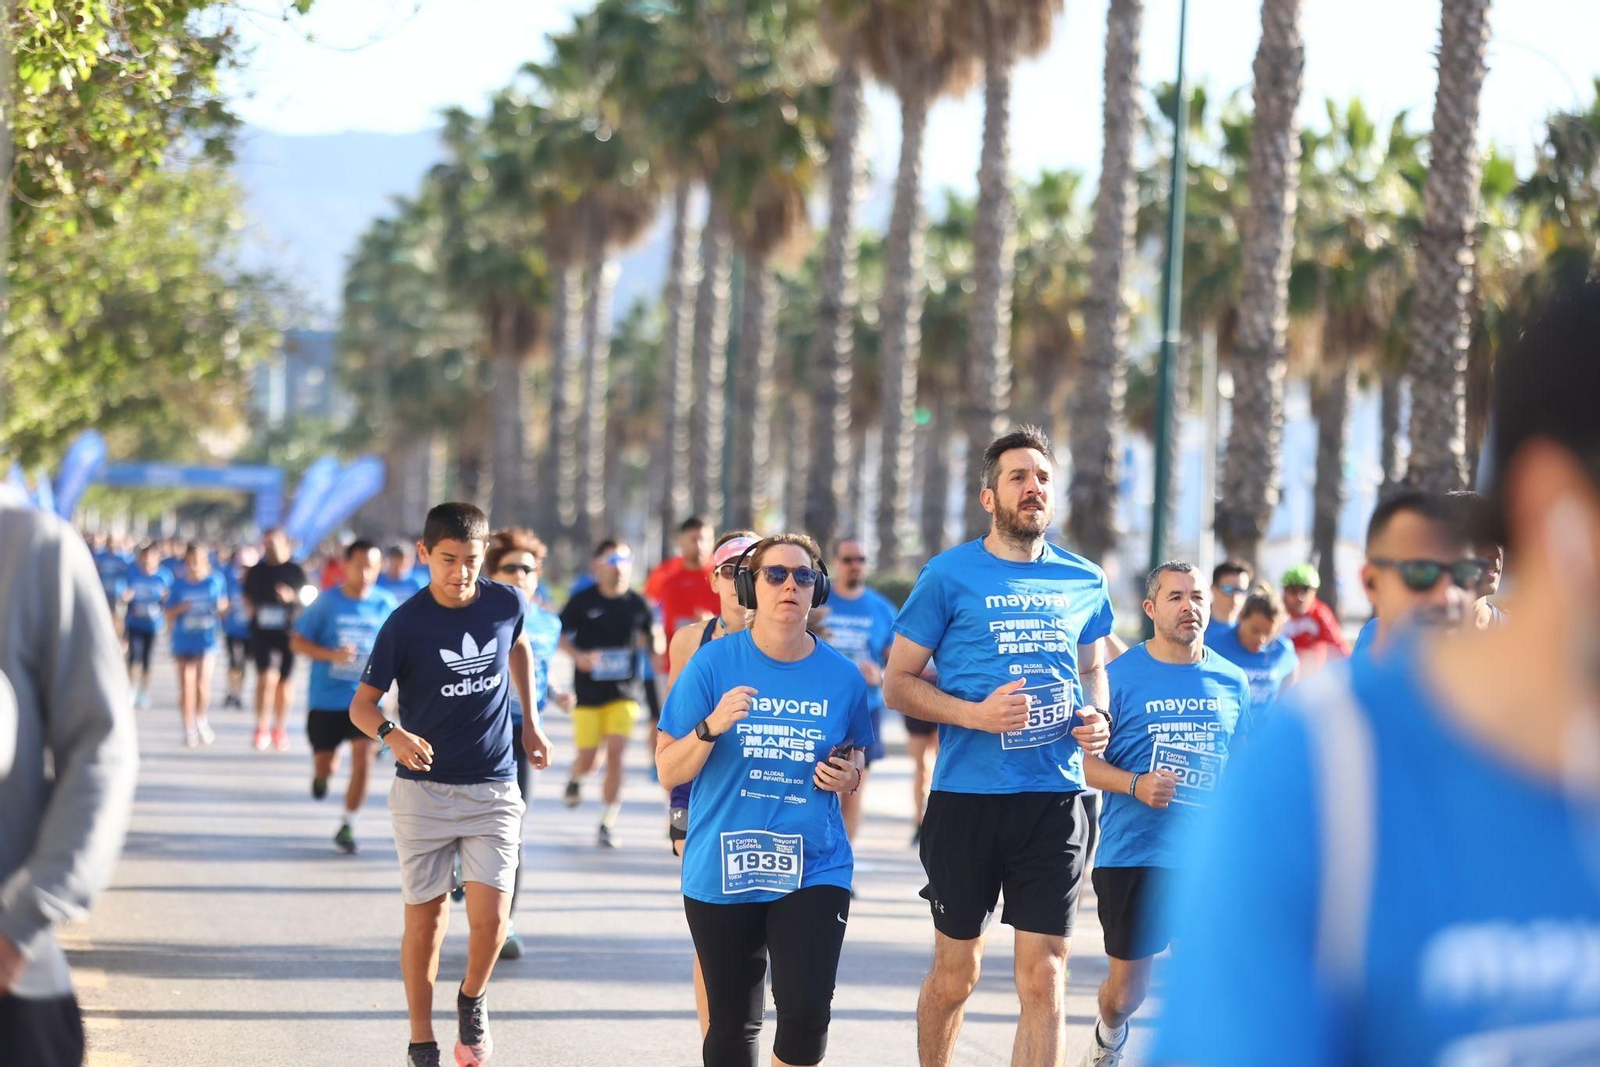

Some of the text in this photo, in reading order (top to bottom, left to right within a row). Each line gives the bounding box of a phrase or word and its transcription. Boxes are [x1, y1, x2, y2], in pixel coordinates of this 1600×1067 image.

[985, 592, 1071, 611] mayoral
[989, 618, 1071, 633] RUNNING
[999, 630, 1066, 643] MAKES
[998, 642, 1067, 654] FRIENDS
[441, 673, 501, 697] adidas
[1145, 696, 1222, 715] mayoral
[1028, 704, 1066, 728] 559
[736, 723, 822, 741] RUNNING
[1147, 722, 1221, 734] RUNNING
[745, 735, 815, 751] MAKES
[1155, 732, 1215, 743] MAKES
[743, 747, 816, 763] FRIENDS
[1166, 751, 1187, 760] Carrera
[762, 775, 793, 784] INFANTILES
[735, 843, 762, 851] Solidaria
[772, 837, 798, 845] mayoral
[733, 852, 793, 871] 1939
